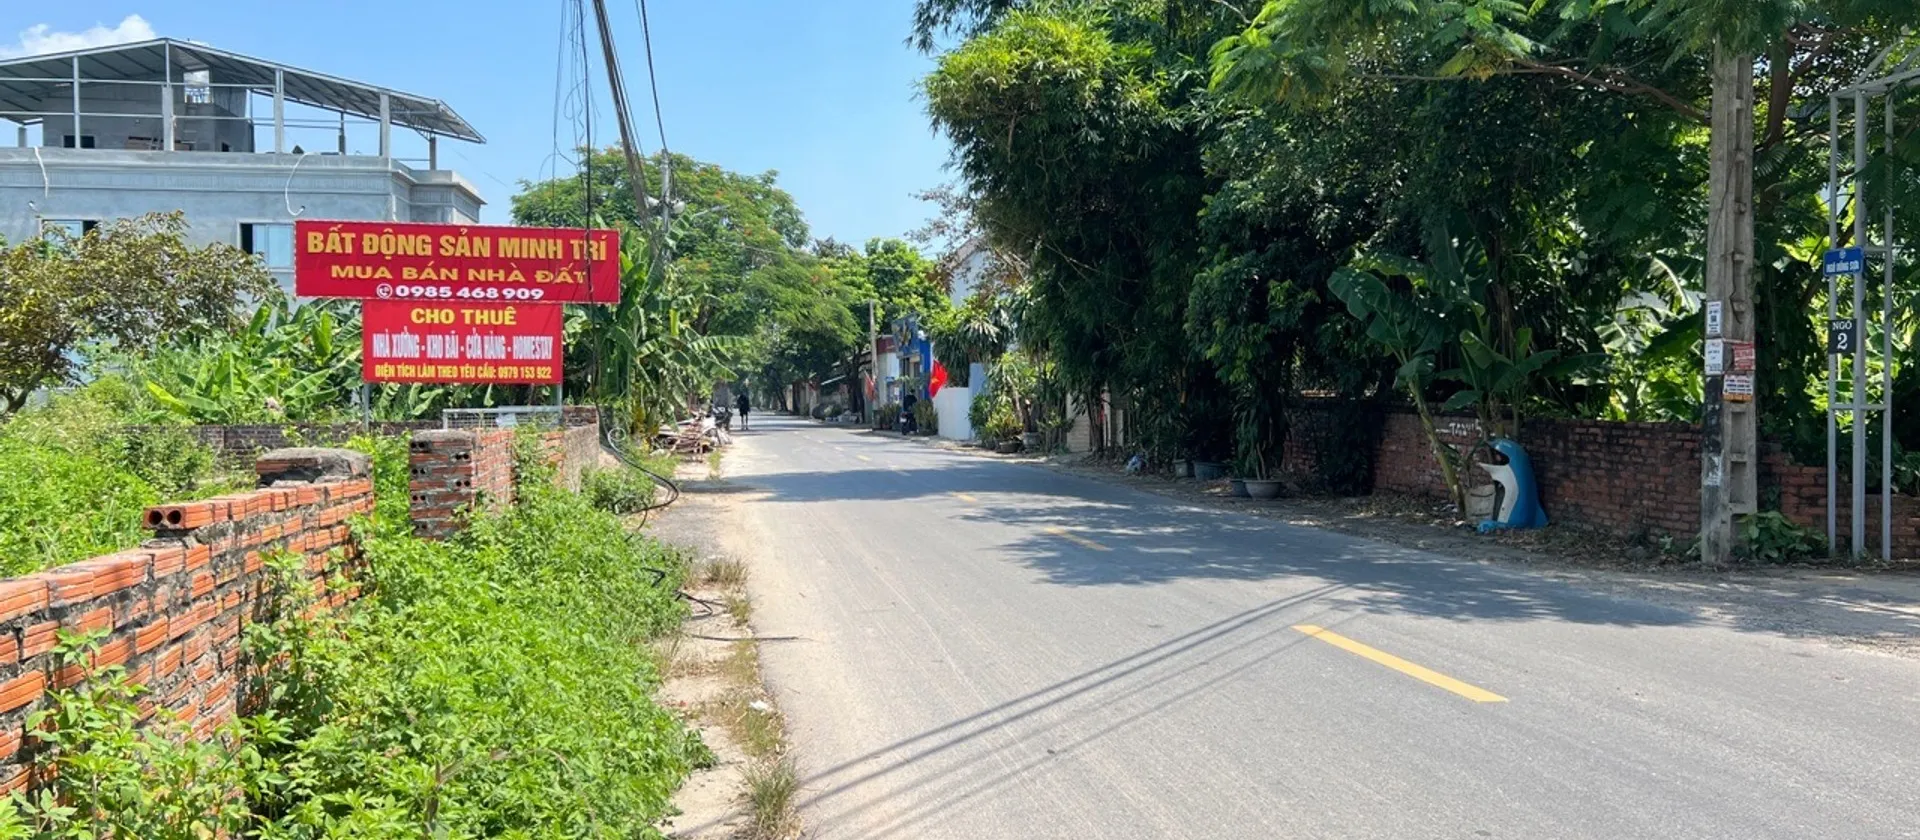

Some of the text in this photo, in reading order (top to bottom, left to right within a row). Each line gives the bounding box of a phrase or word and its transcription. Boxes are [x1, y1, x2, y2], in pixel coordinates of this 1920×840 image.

[307, 224, 607, 260] BẤT ĐỘNG SẢN MINH TRÍ
[331, 261, 586, 284] MUA BÁN NHÀ ĐẤT
[395, 285, 544, 300] 0985 468 909
[411, 306, 517, 325] CHO THUÊ
[427, 334, 443, 359] KHO
[512, 336, 553, 360] HOMESTAY
[1836, 332, 1848, 350] 2
[437, 365, 458, 378] THEO
[520, 366, 534, 378] 153
[536, 366, 552, 379] 922
